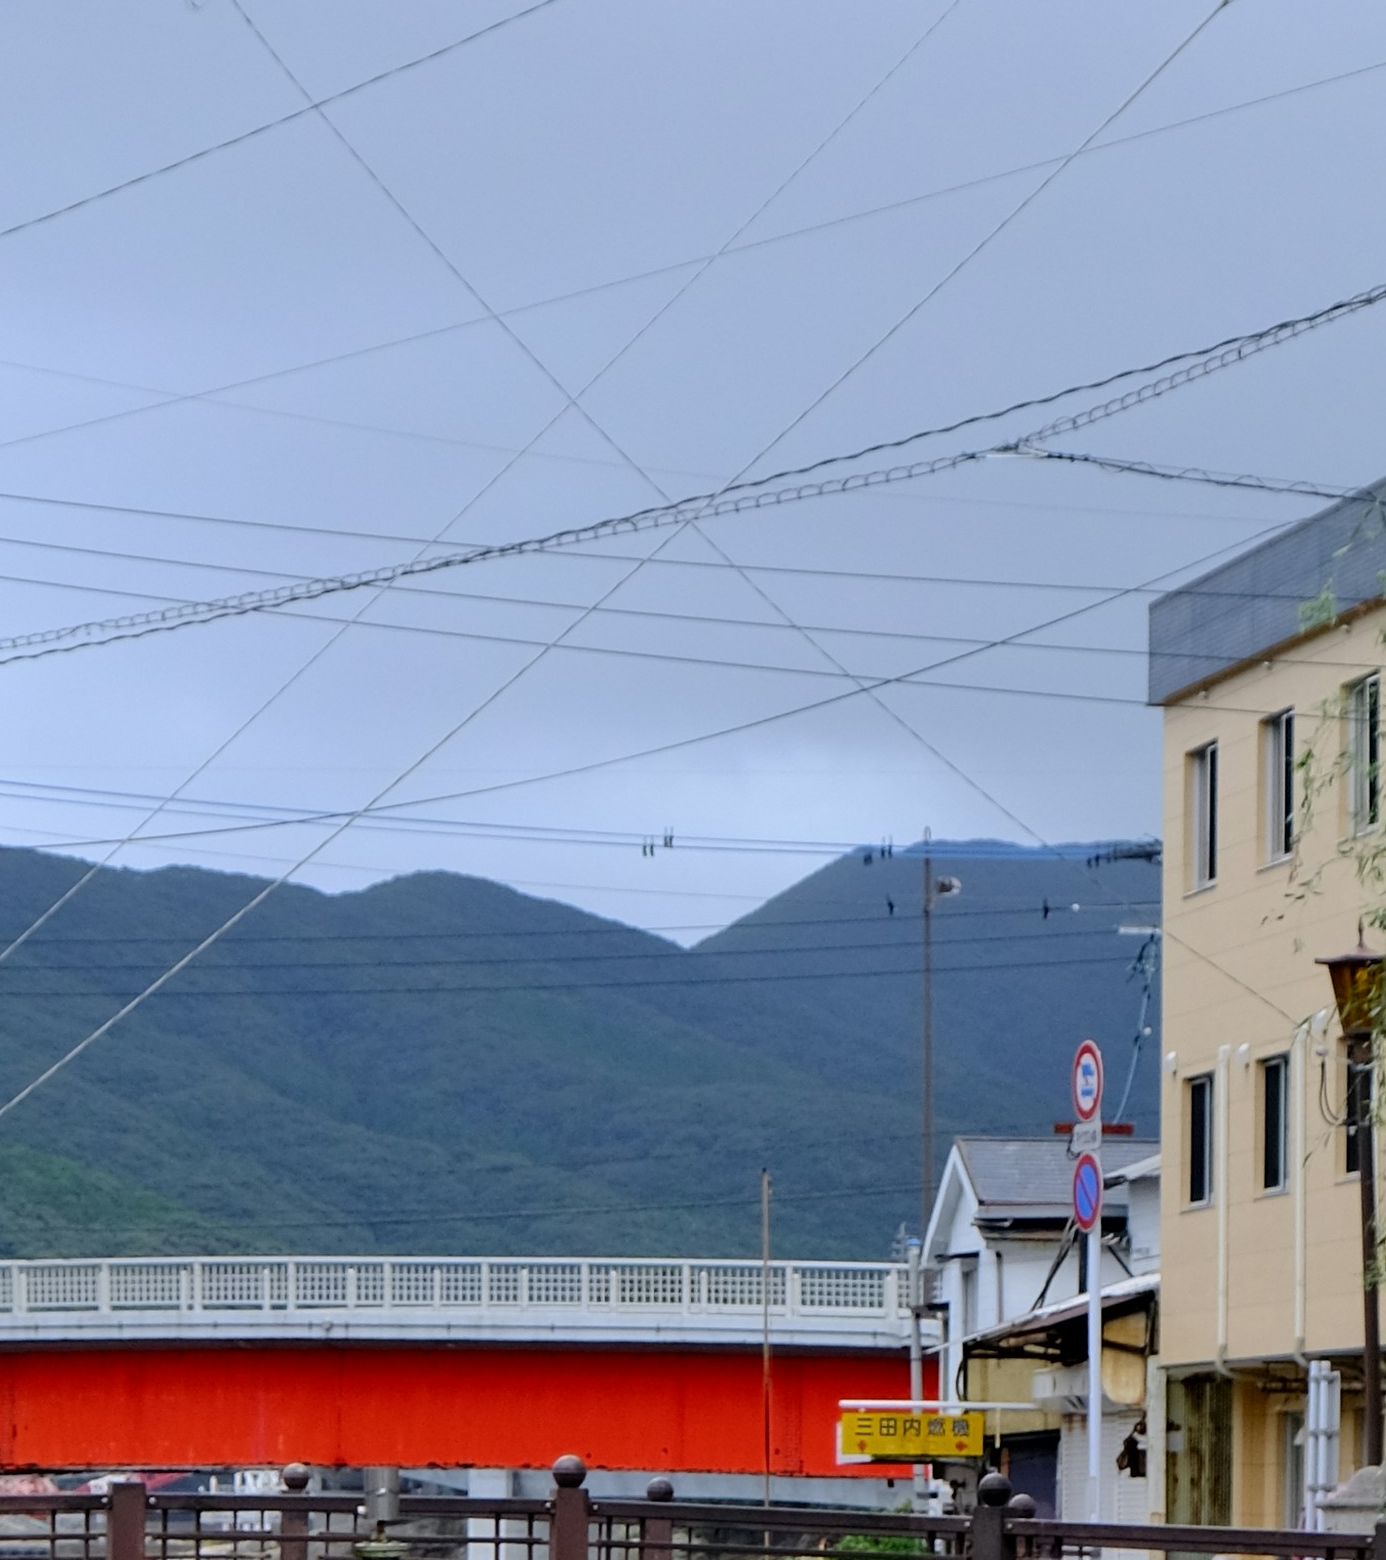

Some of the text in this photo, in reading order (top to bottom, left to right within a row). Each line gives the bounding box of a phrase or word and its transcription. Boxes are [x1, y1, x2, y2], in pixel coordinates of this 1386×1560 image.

[855, 1417, 970, 1437] 三田内燃機
